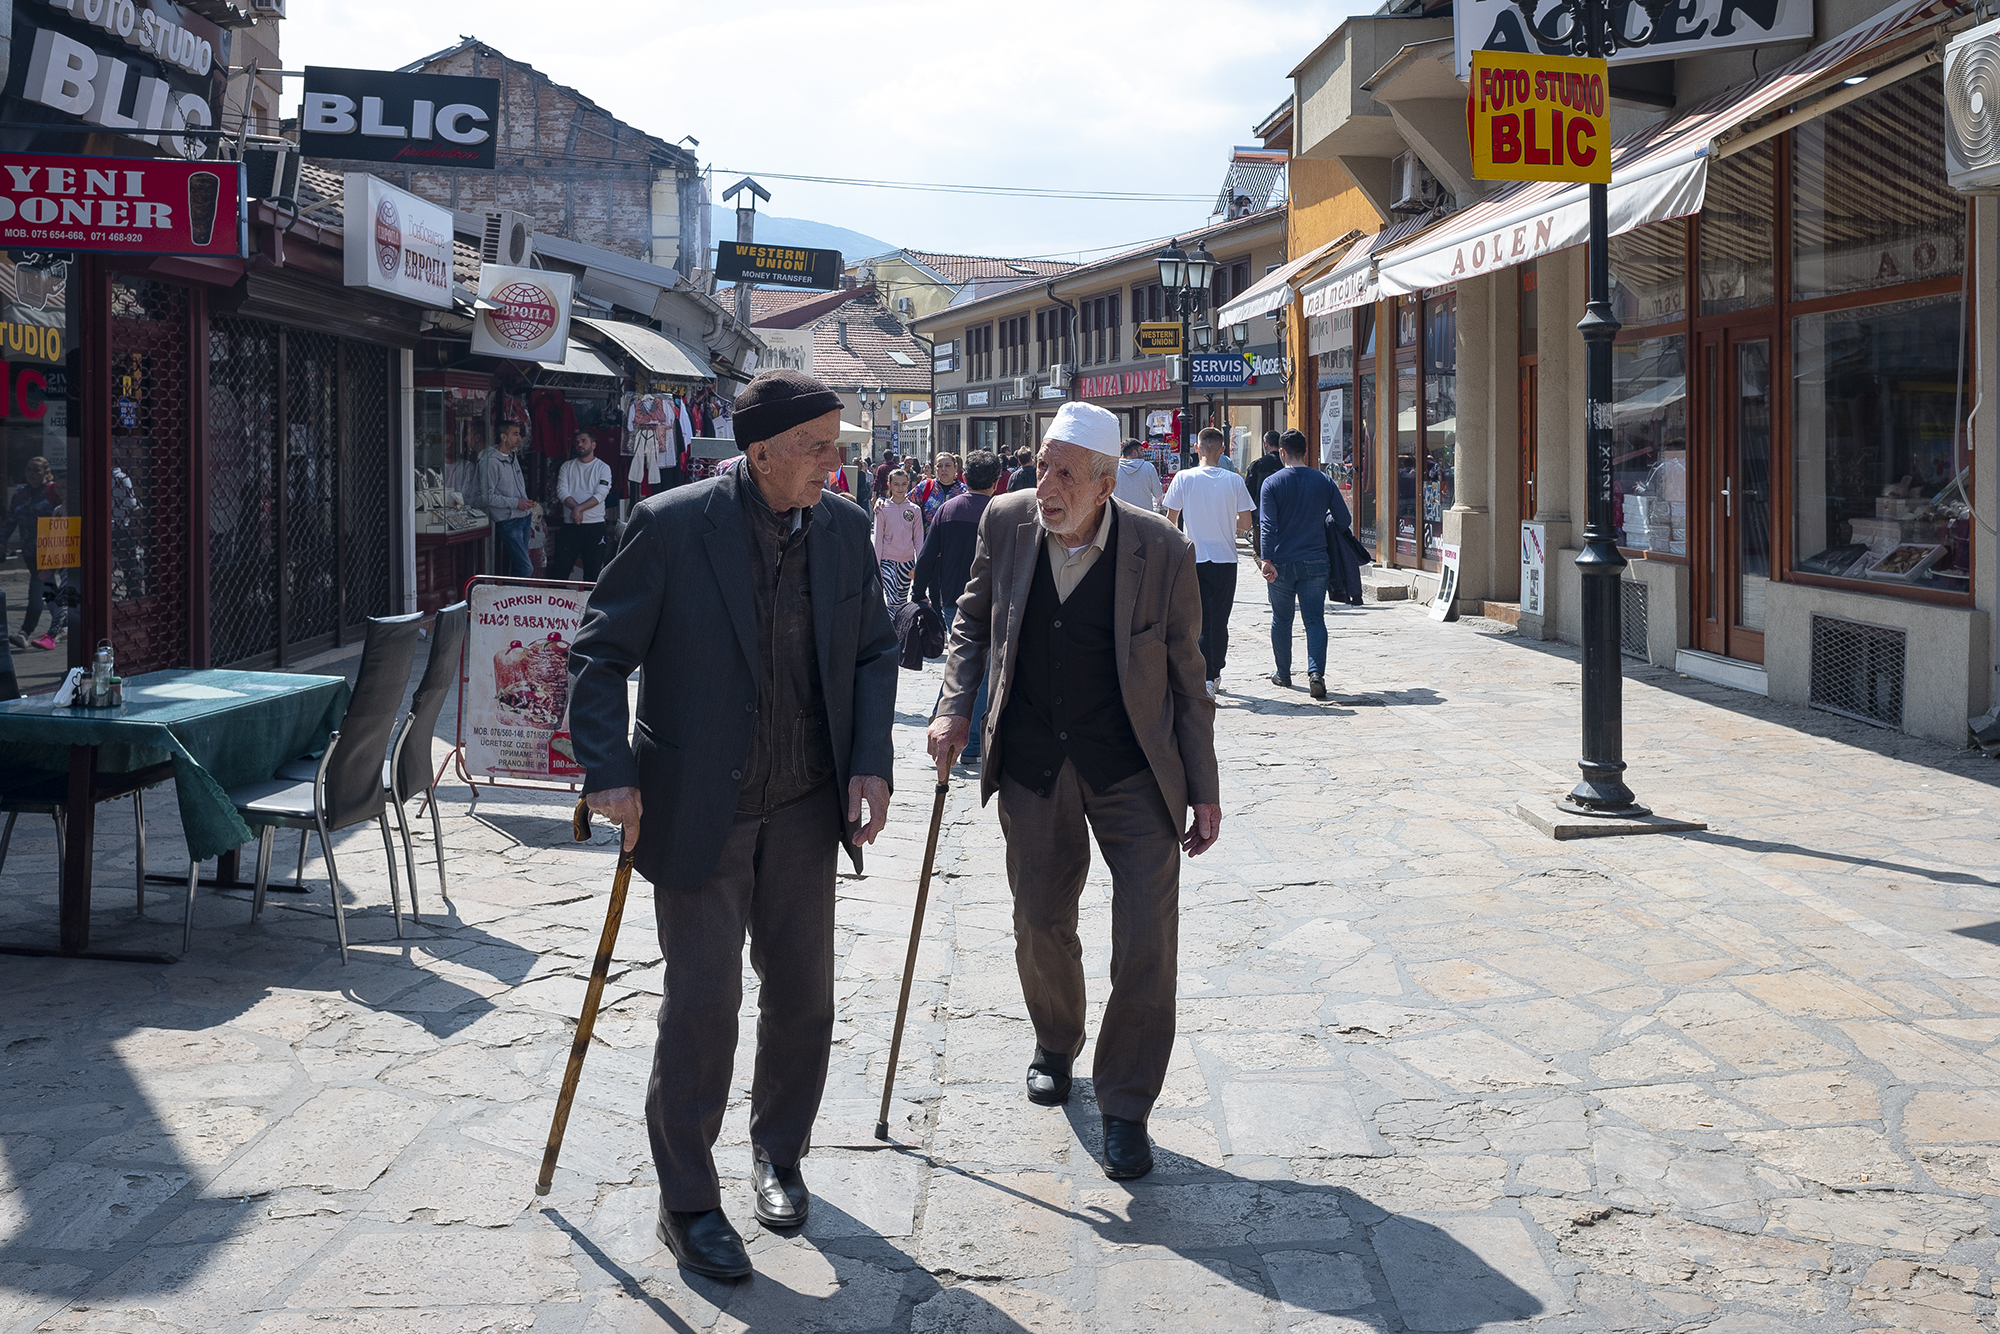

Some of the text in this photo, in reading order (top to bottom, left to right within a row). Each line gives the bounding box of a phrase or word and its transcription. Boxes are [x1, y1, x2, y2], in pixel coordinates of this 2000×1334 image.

[66, 0, 212, 76] OTO STUDIO
[38, 30, 213, 160] BLIC
[1480, 68, 1603, 118] FOTO STUDIO
[303, 91, 490, 145] BLIC
[1491, 109, 1597, 167] BLIC
[393, 142, 480, 160] production
[4, 165, 145, 197] YENI
[5, 228, 143, 242] MOB. 075 654-668, 071 468-920
[735, 245, 805, 261] WESTERN
[1451, 216, 1555, 276] AOLEN
[404, 248, 447, 289] ЕВРОПА
[755, 257, 804, 271] UNION
[741, 270, 813, 283] MONEY TRANSFER
[506, 341, 529, 350] 1882
[1151, 338, 1174, 346] UNION
[1192, 360, 1242, 373] SERVIS
[1081, 373, 1122, 398] HAMZA
[1124, 368, 1168, 394] DONER
[1192, 374, 1242, 382] ZA MOBILNI
[49, 518, 69, 530] FOTO
[38, 536, 80, 547] DOKUMENT
[41, 554, 76, 565] ZA 5 MIN
[493, 595, 542, 611] TURKISH
[473, 727, 489, 736] MOB.
[500, 750, 533, 759] ПРИМАМЕ
[552, 760, 564, 768] 100
